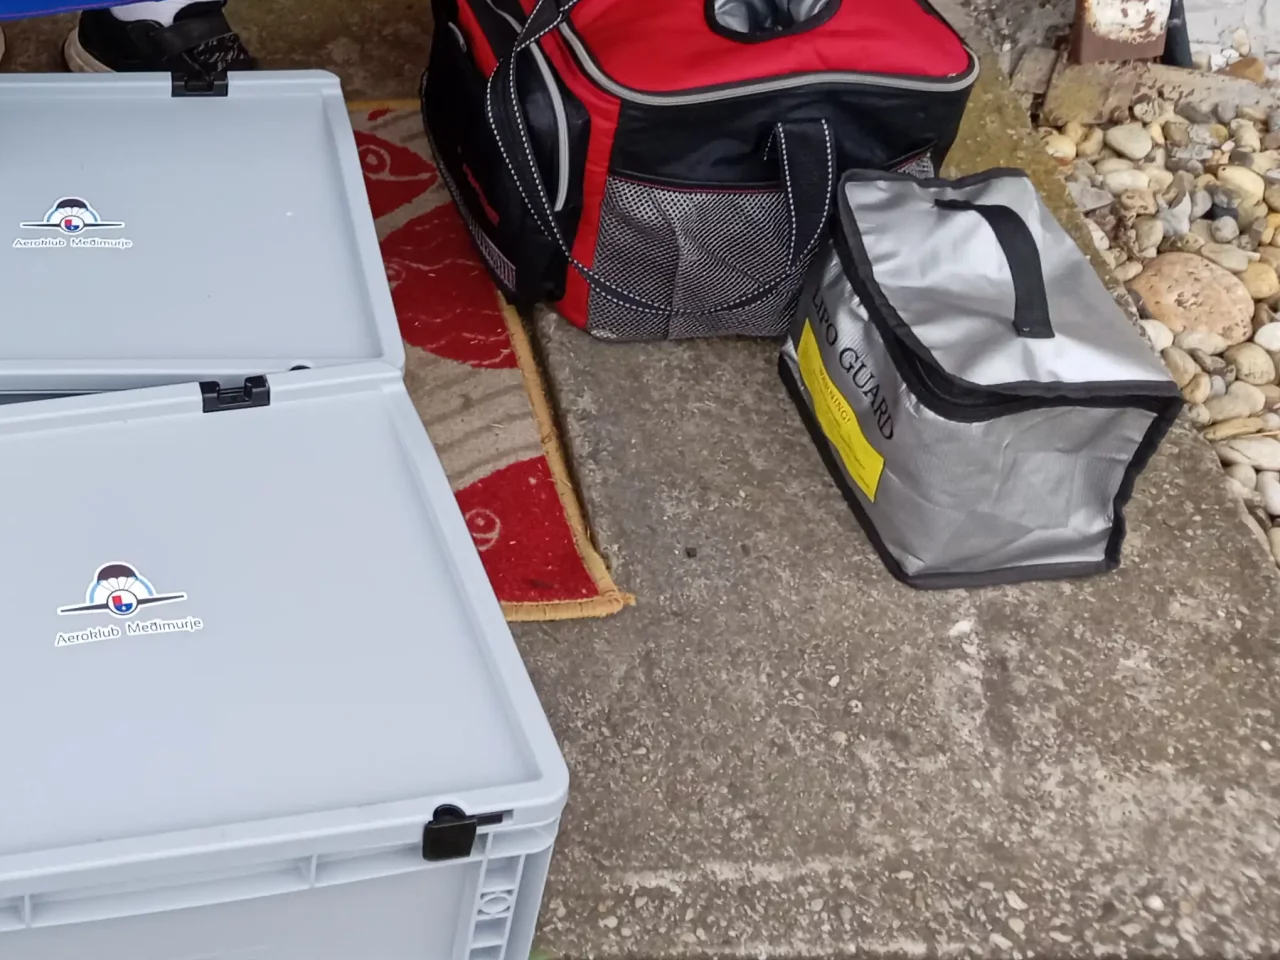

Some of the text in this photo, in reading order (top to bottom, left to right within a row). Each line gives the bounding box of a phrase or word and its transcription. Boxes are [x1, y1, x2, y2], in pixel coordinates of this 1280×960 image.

[13, 238, 66, 247] Aeroklub
[812, 290, 838, 346] LIPO
[839, 347, 894, 440] GUARD
[56, 618, 202, 645] Aeroklub Međimurje
